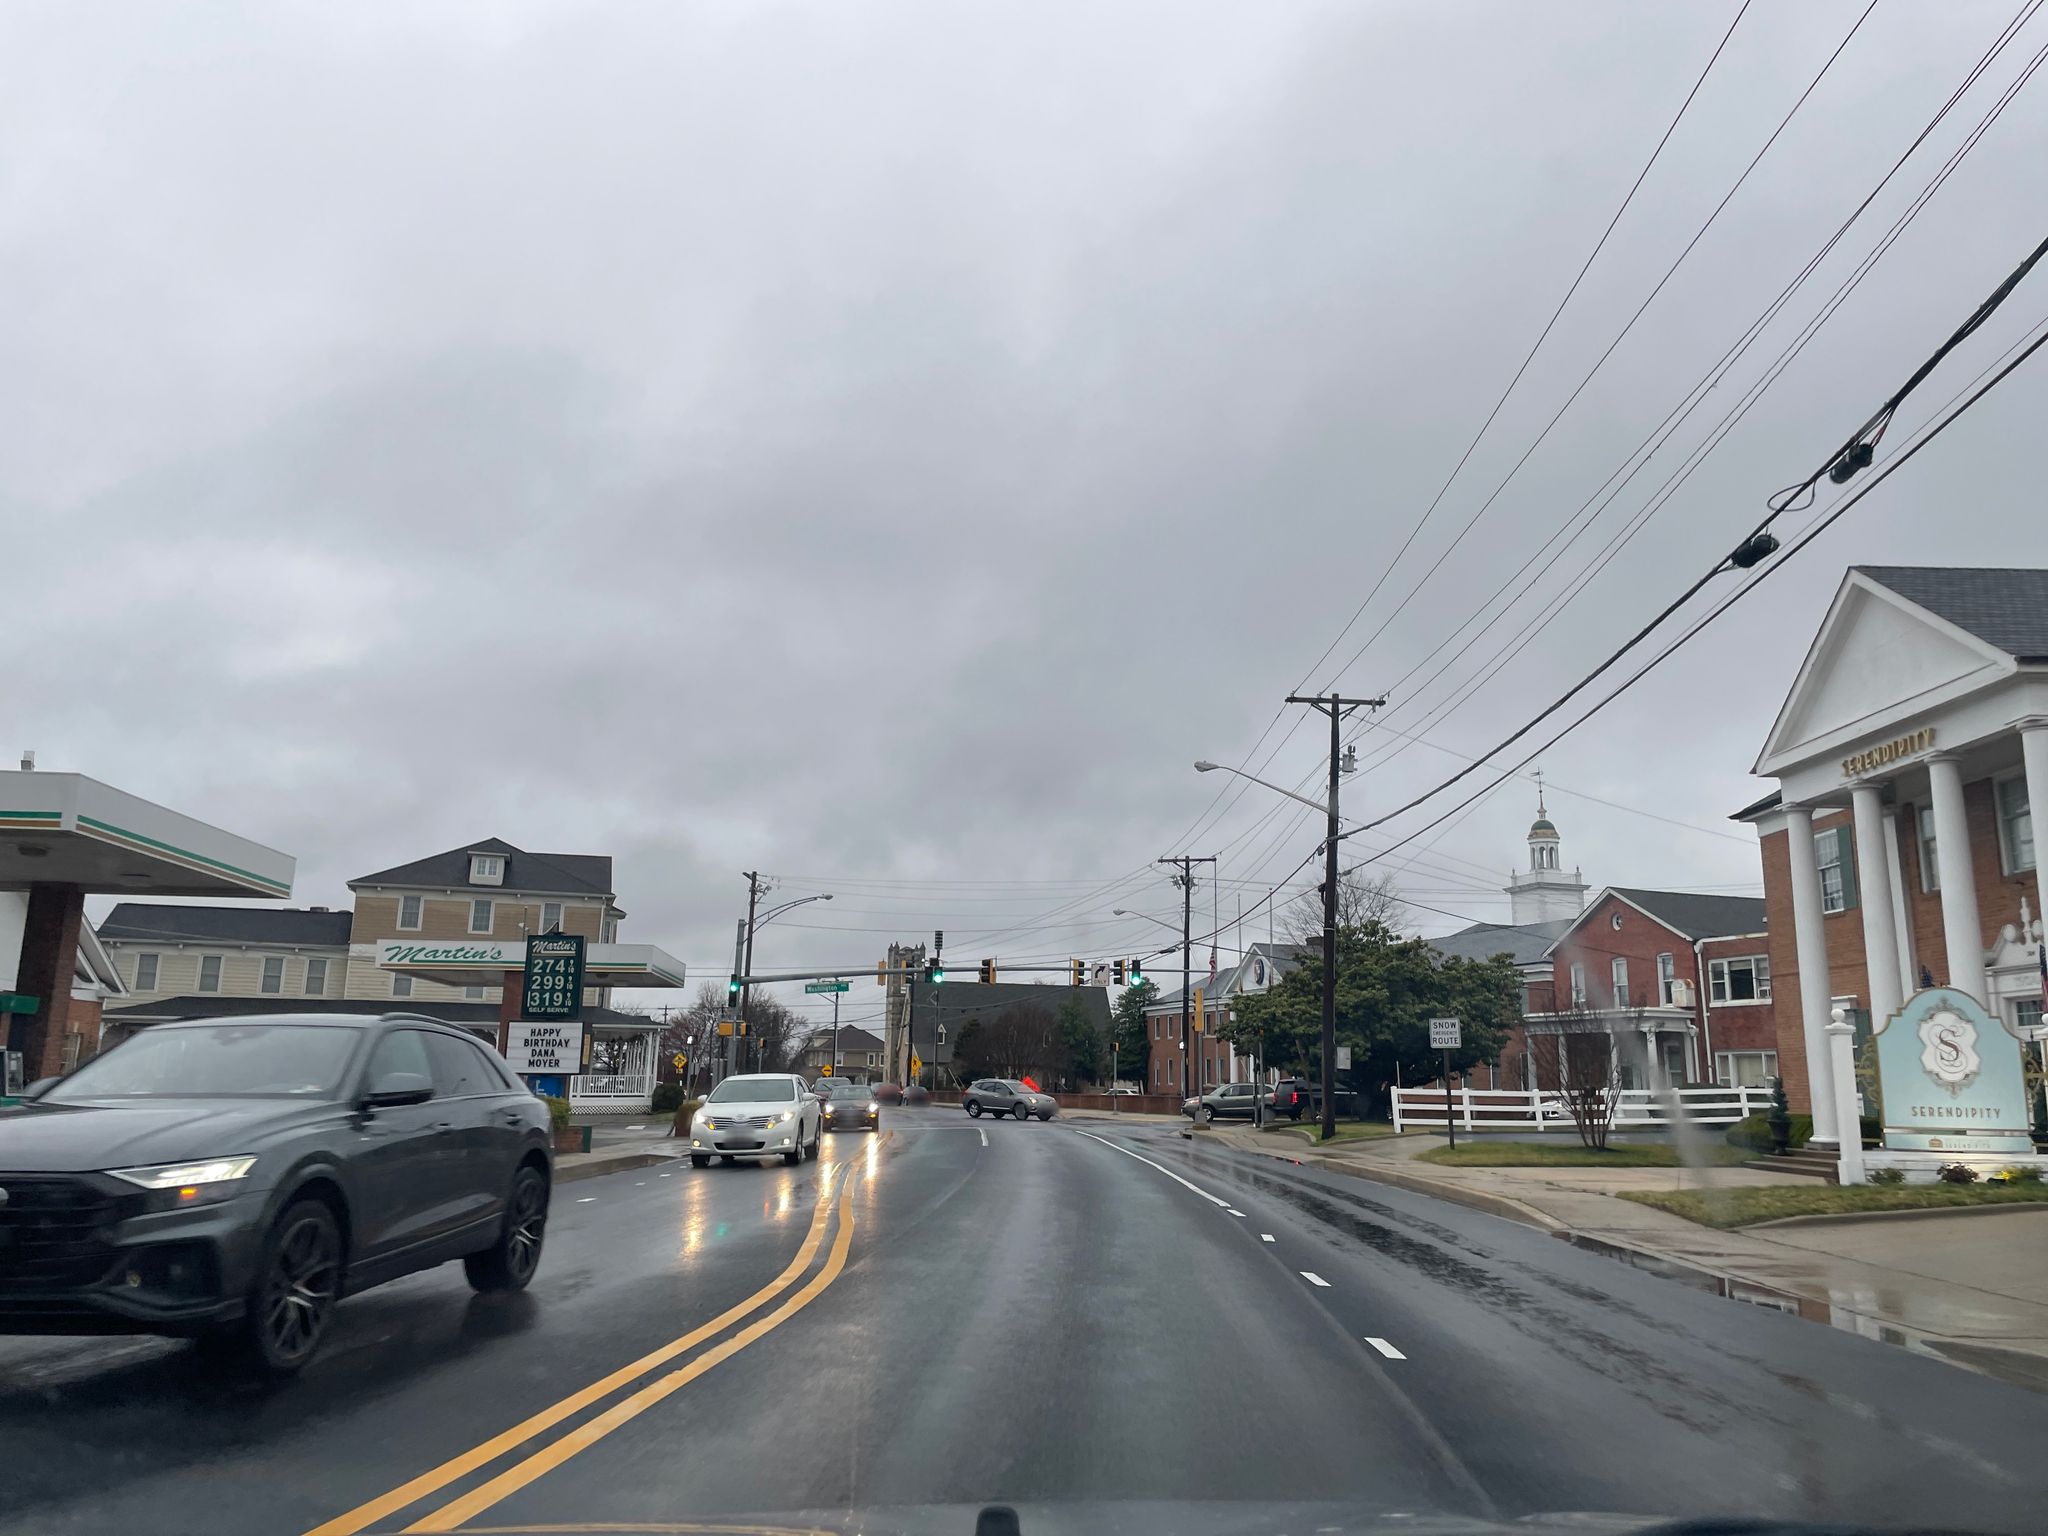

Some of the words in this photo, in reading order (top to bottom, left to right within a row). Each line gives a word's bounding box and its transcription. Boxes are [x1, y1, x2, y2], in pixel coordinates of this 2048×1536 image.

[1841, 728, 1936, 777] SERENDIPITY
[384, 945, 504, 962] Martin's
[532, 941, 576, 953] Martin's
[533, 959, 565, 973] 274
[532, 975, 564, 990] 299
[530, 992, 563, 1007] 319
[530, 1028, 562, 1037] HAPPY
[523, 1039, 570, 1048] BIRTHDAY
[531, 1049, 556, 1058] DANA
[528, 1059, 560, 1068] MOYER
[1911, 1106, 2001, 1119] SERENDIPITY
